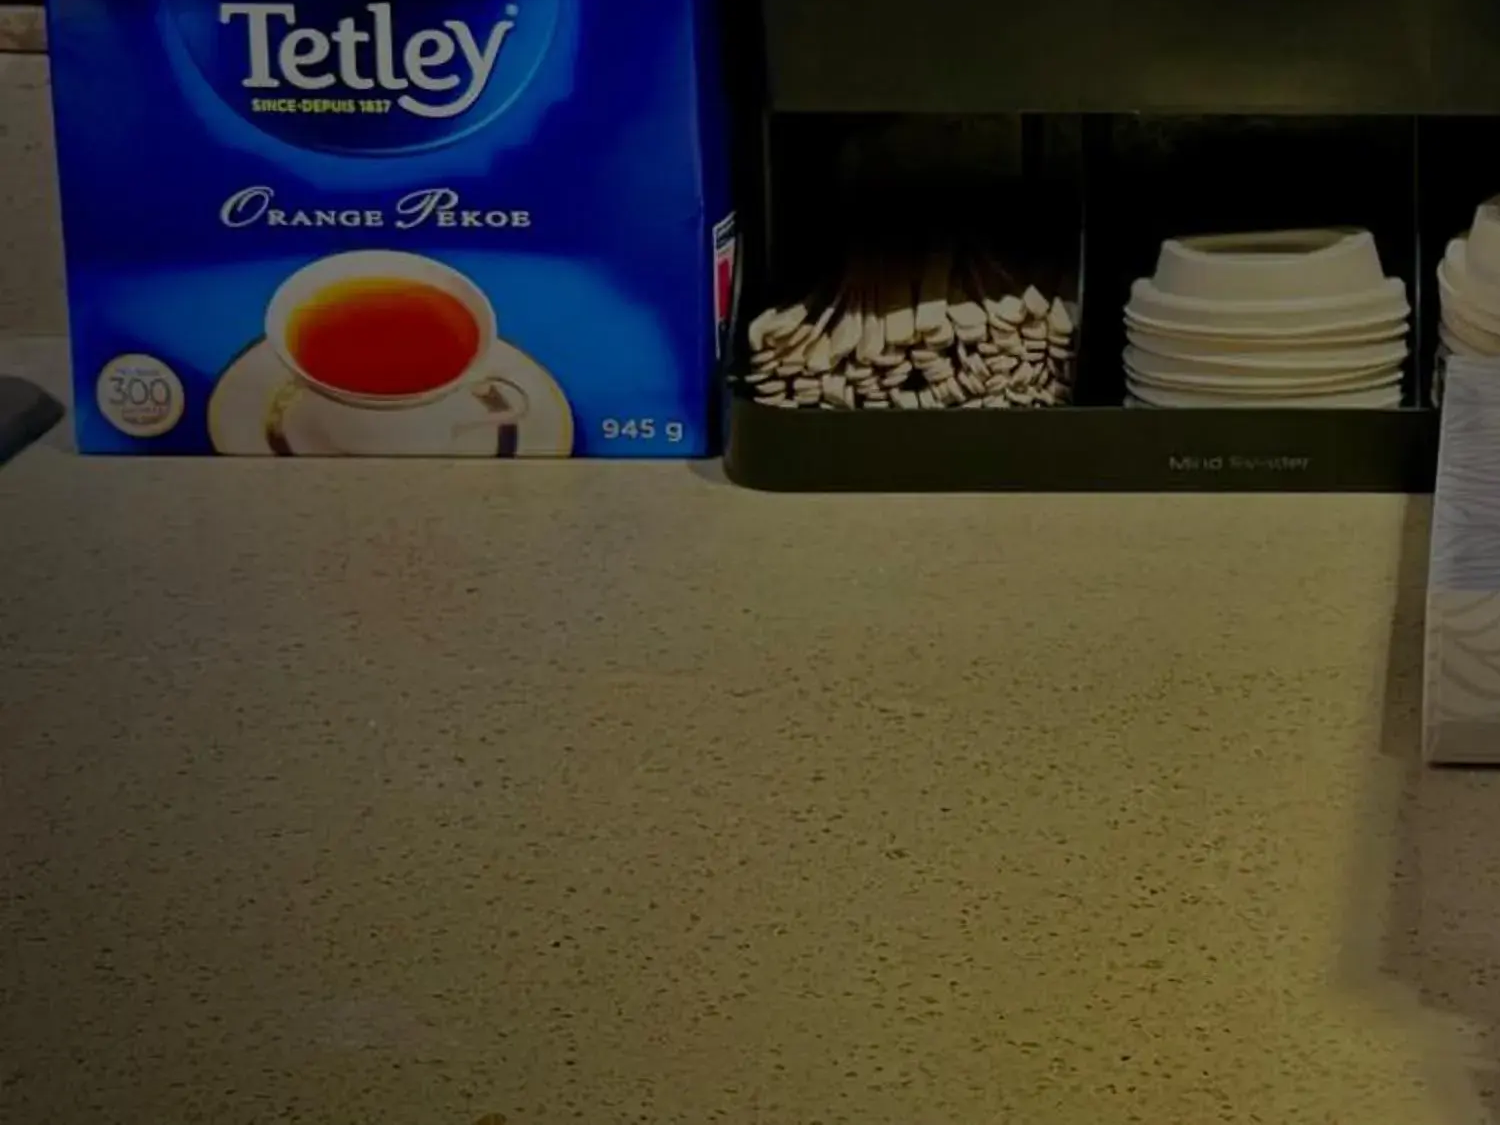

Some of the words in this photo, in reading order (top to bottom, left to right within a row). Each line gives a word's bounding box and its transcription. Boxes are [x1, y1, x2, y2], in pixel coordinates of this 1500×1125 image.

[218, 1, 519, 118] Tetley
[108, 376, 171, 406] 300
[602, 418, 656, 439] 945
[665, 422, 684, 443] g
